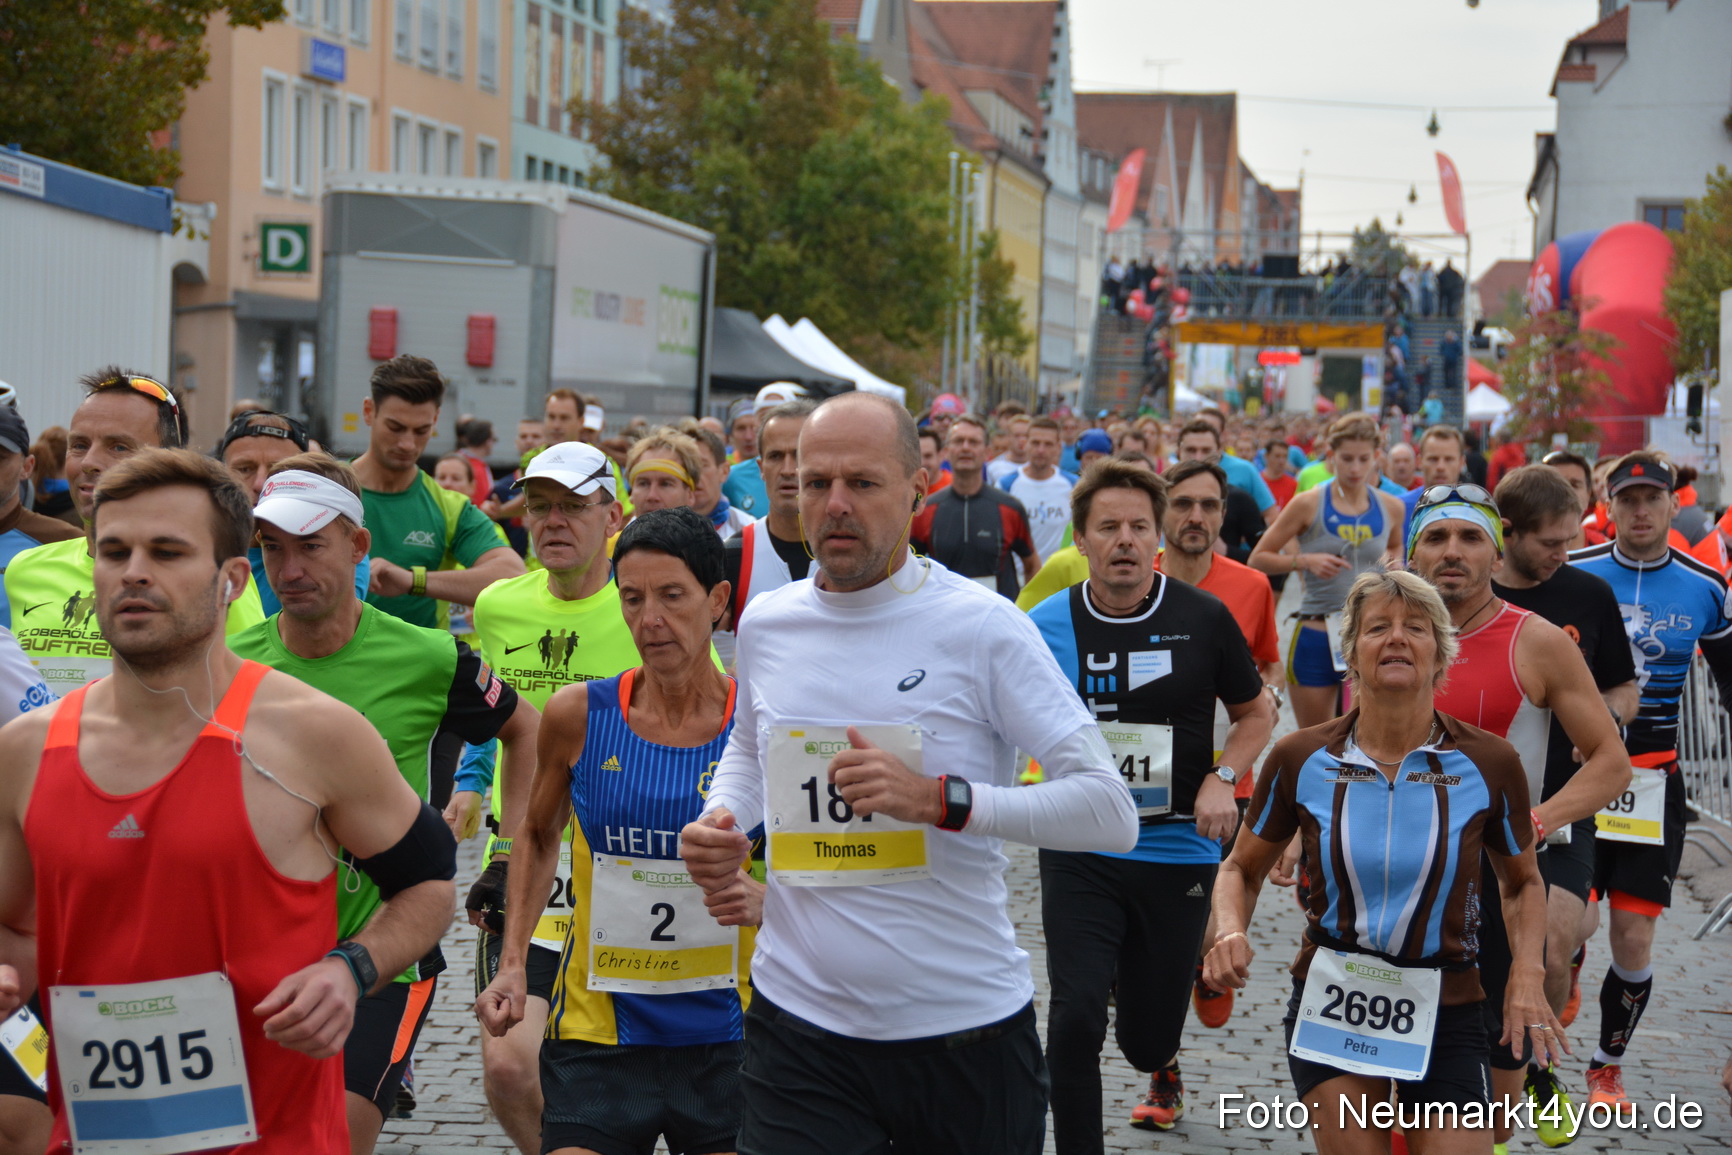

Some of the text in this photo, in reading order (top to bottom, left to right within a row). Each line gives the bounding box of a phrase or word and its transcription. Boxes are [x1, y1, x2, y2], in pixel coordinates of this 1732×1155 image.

[402, 530, 436, 547] AOK
[46, 669, 86, 681] BOCK
[500, 667, 512, 676] SC
[1107, 732, 1142, 742] BOCK
[1112, 753, 1151, 782] 41
[774, 817, 780, 826] A
[1607, 819, 1631, 830] Klaus
[108, 830, 145, 838] adidas
[813, 841, 877, 858] Thomas
[645, 871, 694, 885] BOCK
[650, 902, 676, 942] 2
[597, 931, 603, 939] D
[597, 951, 681, 971] Christine
[1356, 963, 1402, 982] BOCK
[113, 996, 177, 1016] BOCK
[1306, 1008, 1313, 1017] D
[1319, 983, 1416, 1035] 2698
[1343, 1037, 1379, 1057] Petra
[82, 1029, 214, 1090] 2915
[73, 1083, 80, 1094] D
